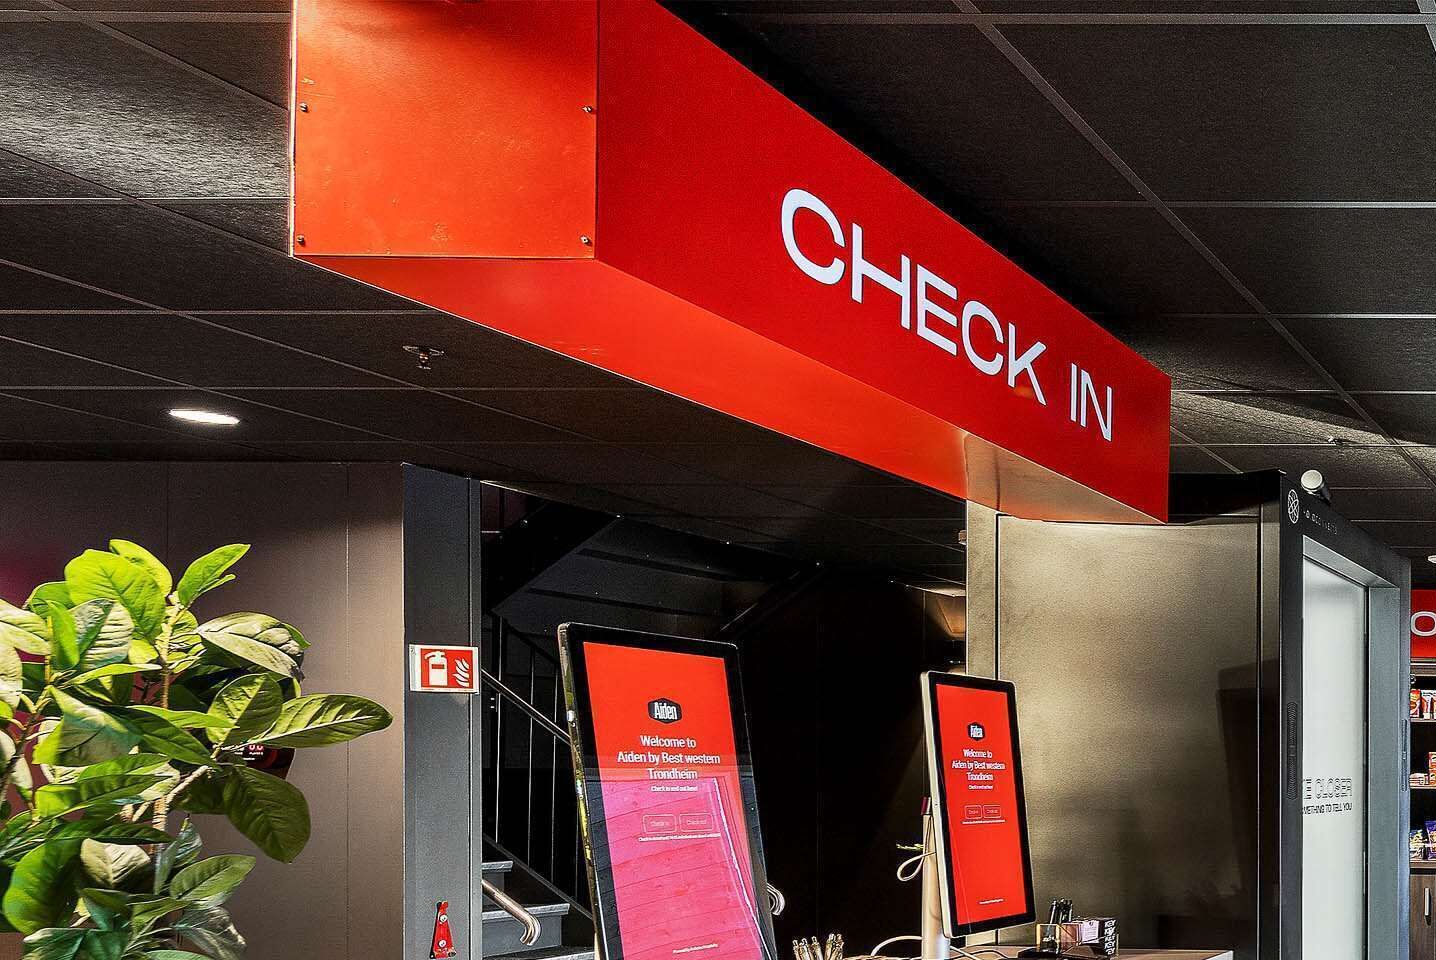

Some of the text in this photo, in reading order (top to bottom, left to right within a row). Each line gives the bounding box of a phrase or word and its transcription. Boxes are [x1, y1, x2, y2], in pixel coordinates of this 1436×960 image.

[781, 188, 1113, 442] CHECK IN
[654, 702, 678, 720] Aiden
[640, 735, 697, 748] Welcome to
[617, 751, 721, 765] Aiden by Best western
[963, 749, 987, 758] Welcome
[647, 768, 698, 780] Trondheim
